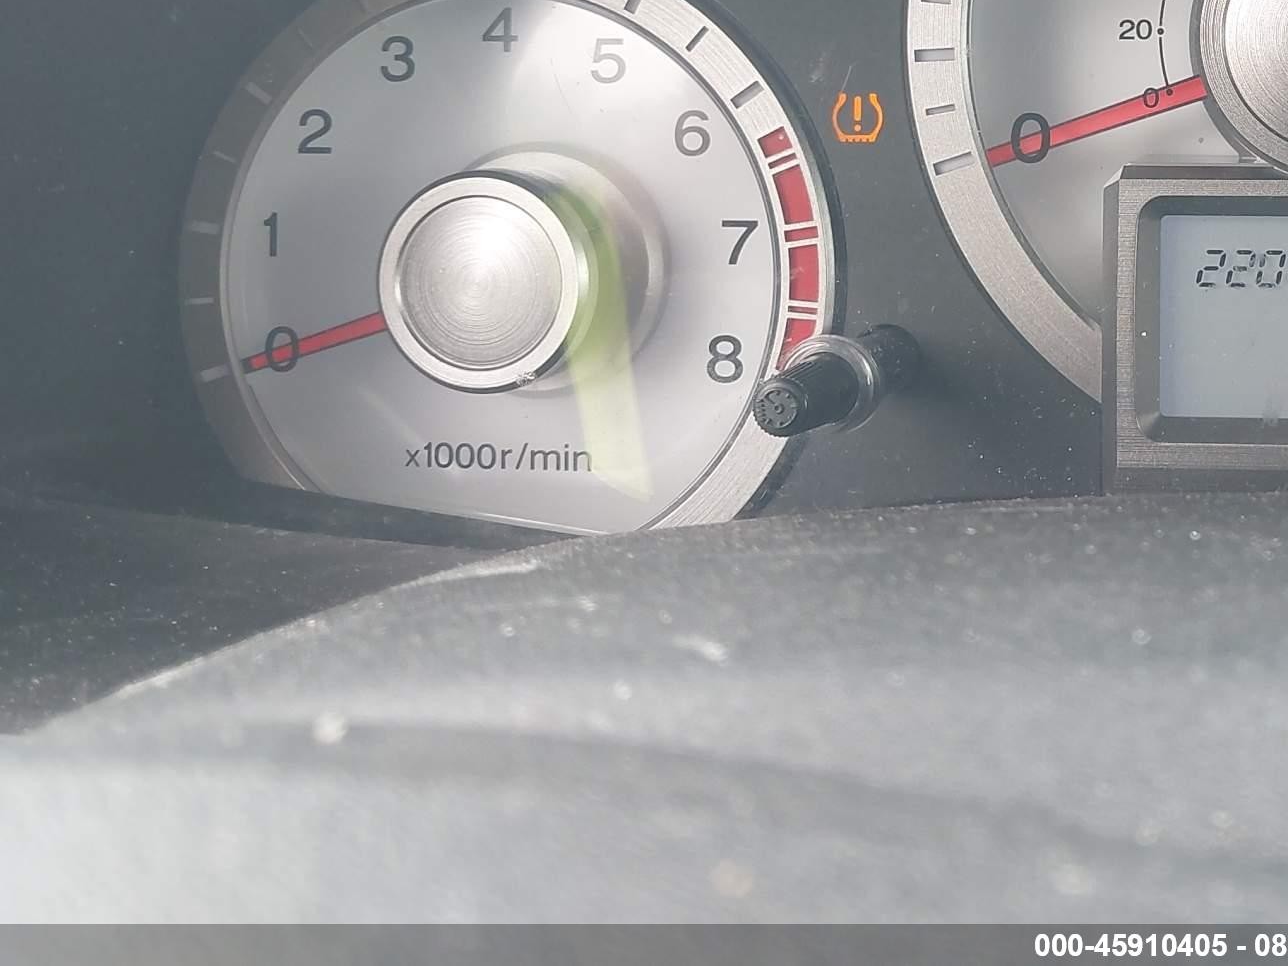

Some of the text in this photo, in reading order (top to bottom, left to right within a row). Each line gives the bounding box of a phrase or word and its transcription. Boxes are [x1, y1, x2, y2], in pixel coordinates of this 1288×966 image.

[481, 7, 519, 53] 4
[1118, 20, 1153, 42] 20
[379, 36, 416, 82] 3
[590, 38, 627, 83] 5
[297, 109, 333, 154] 2
[673, 110, 711, 155] 6
[1011, 112, 1051, 163] 0
[263, 213, 279, 256] 1
[721, 220, 759, 266] 7
[266, 326, 301, 373] 0
[707, 336, 743, 383] 8
